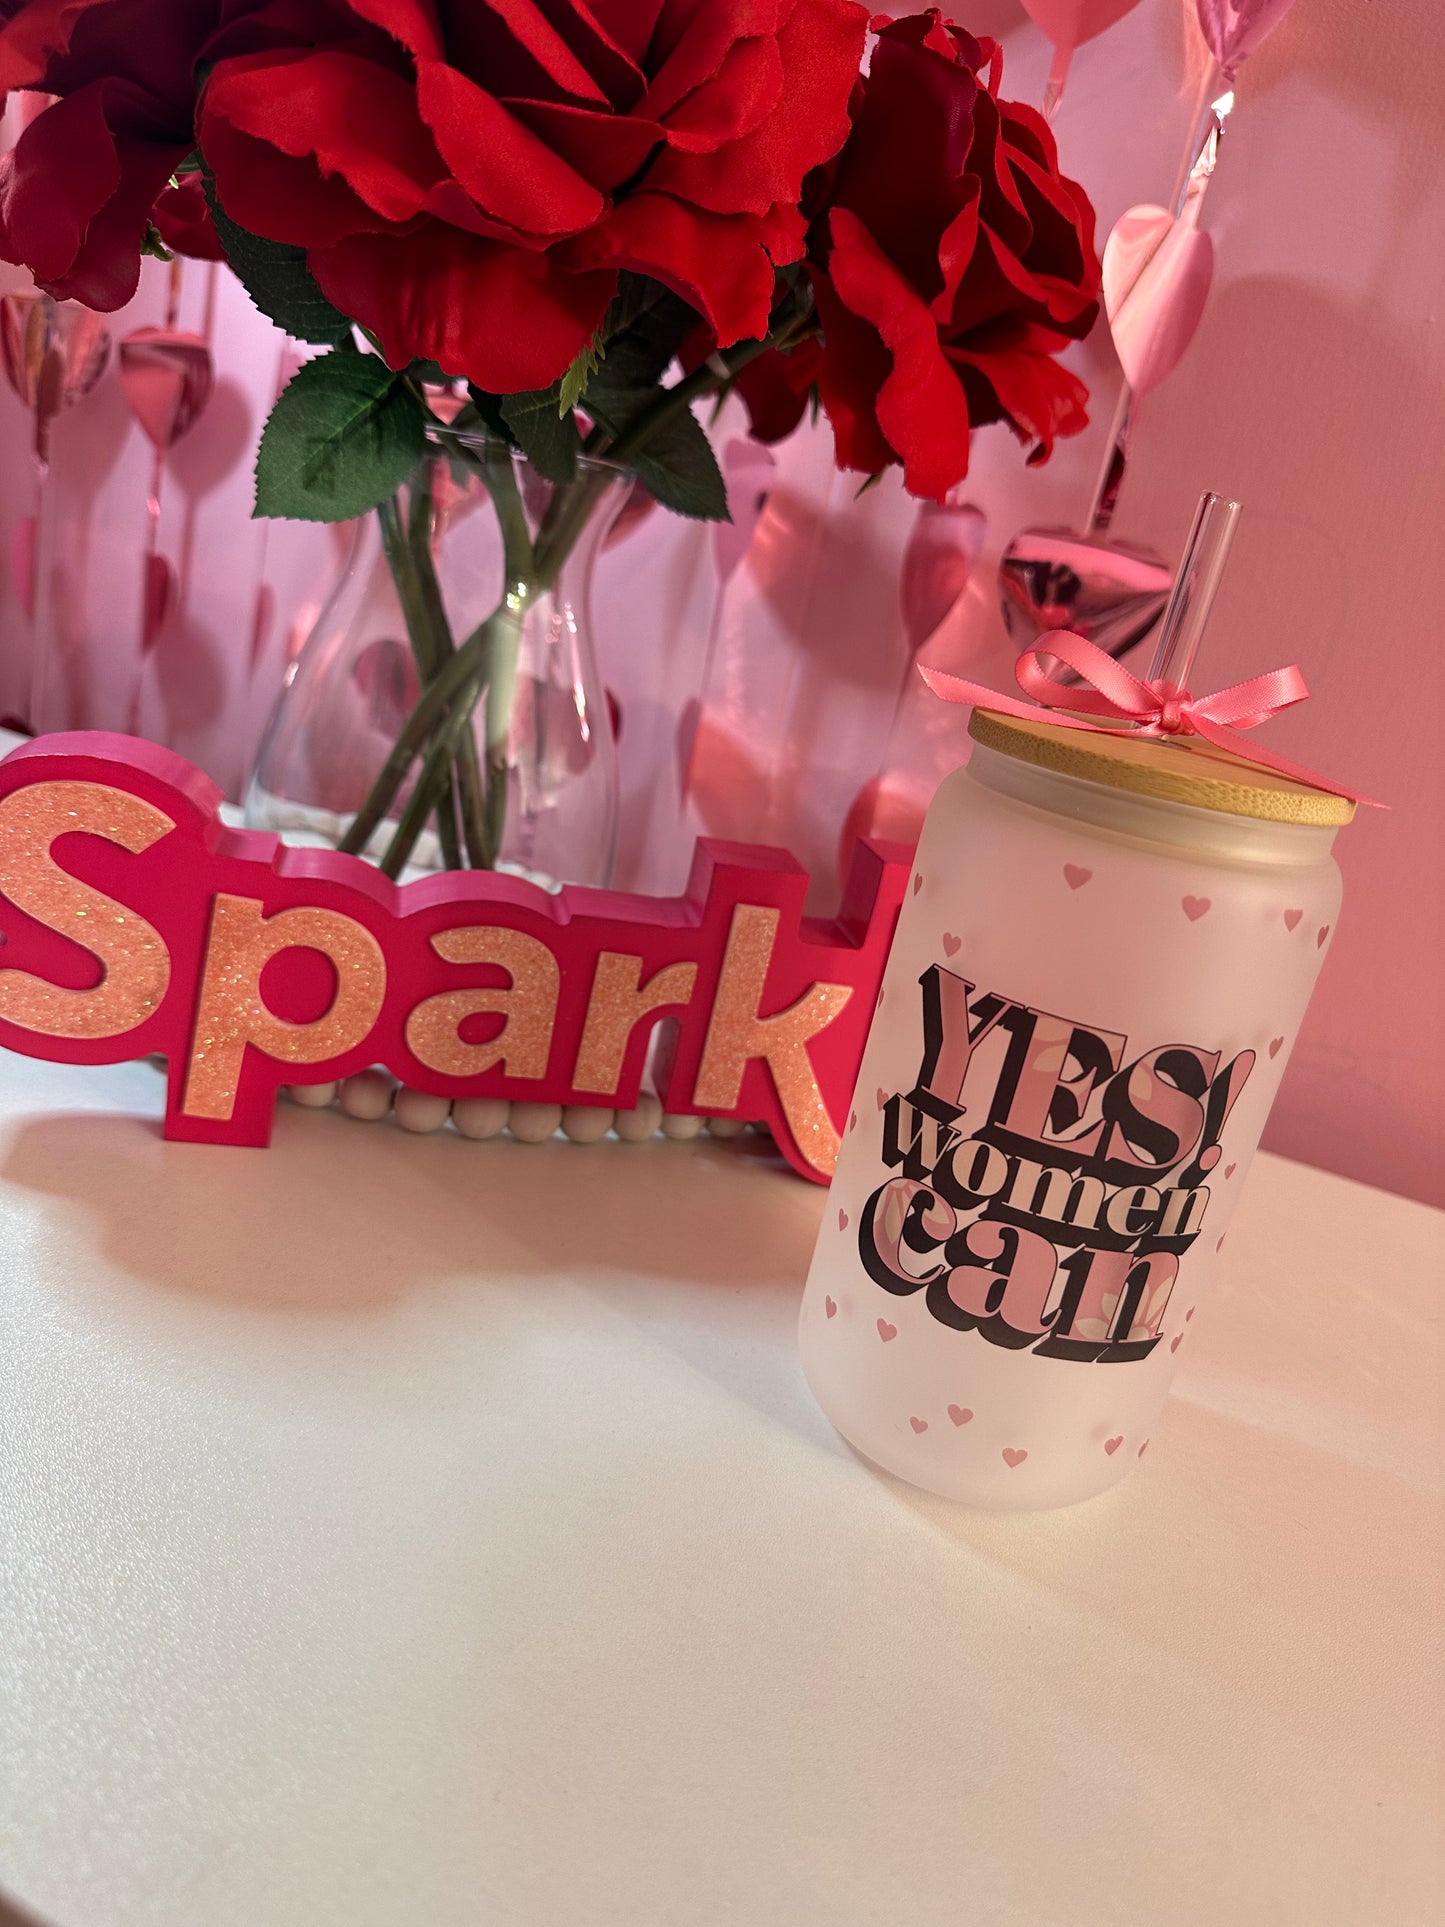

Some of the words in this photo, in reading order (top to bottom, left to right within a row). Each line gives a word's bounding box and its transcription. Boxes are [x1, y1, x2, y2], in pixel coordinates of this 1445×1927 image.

[918, 963, 1256, 1187] YES!
[881, 1092, 1210, 1253] women
[858, 1176, 1180, 1363] can
